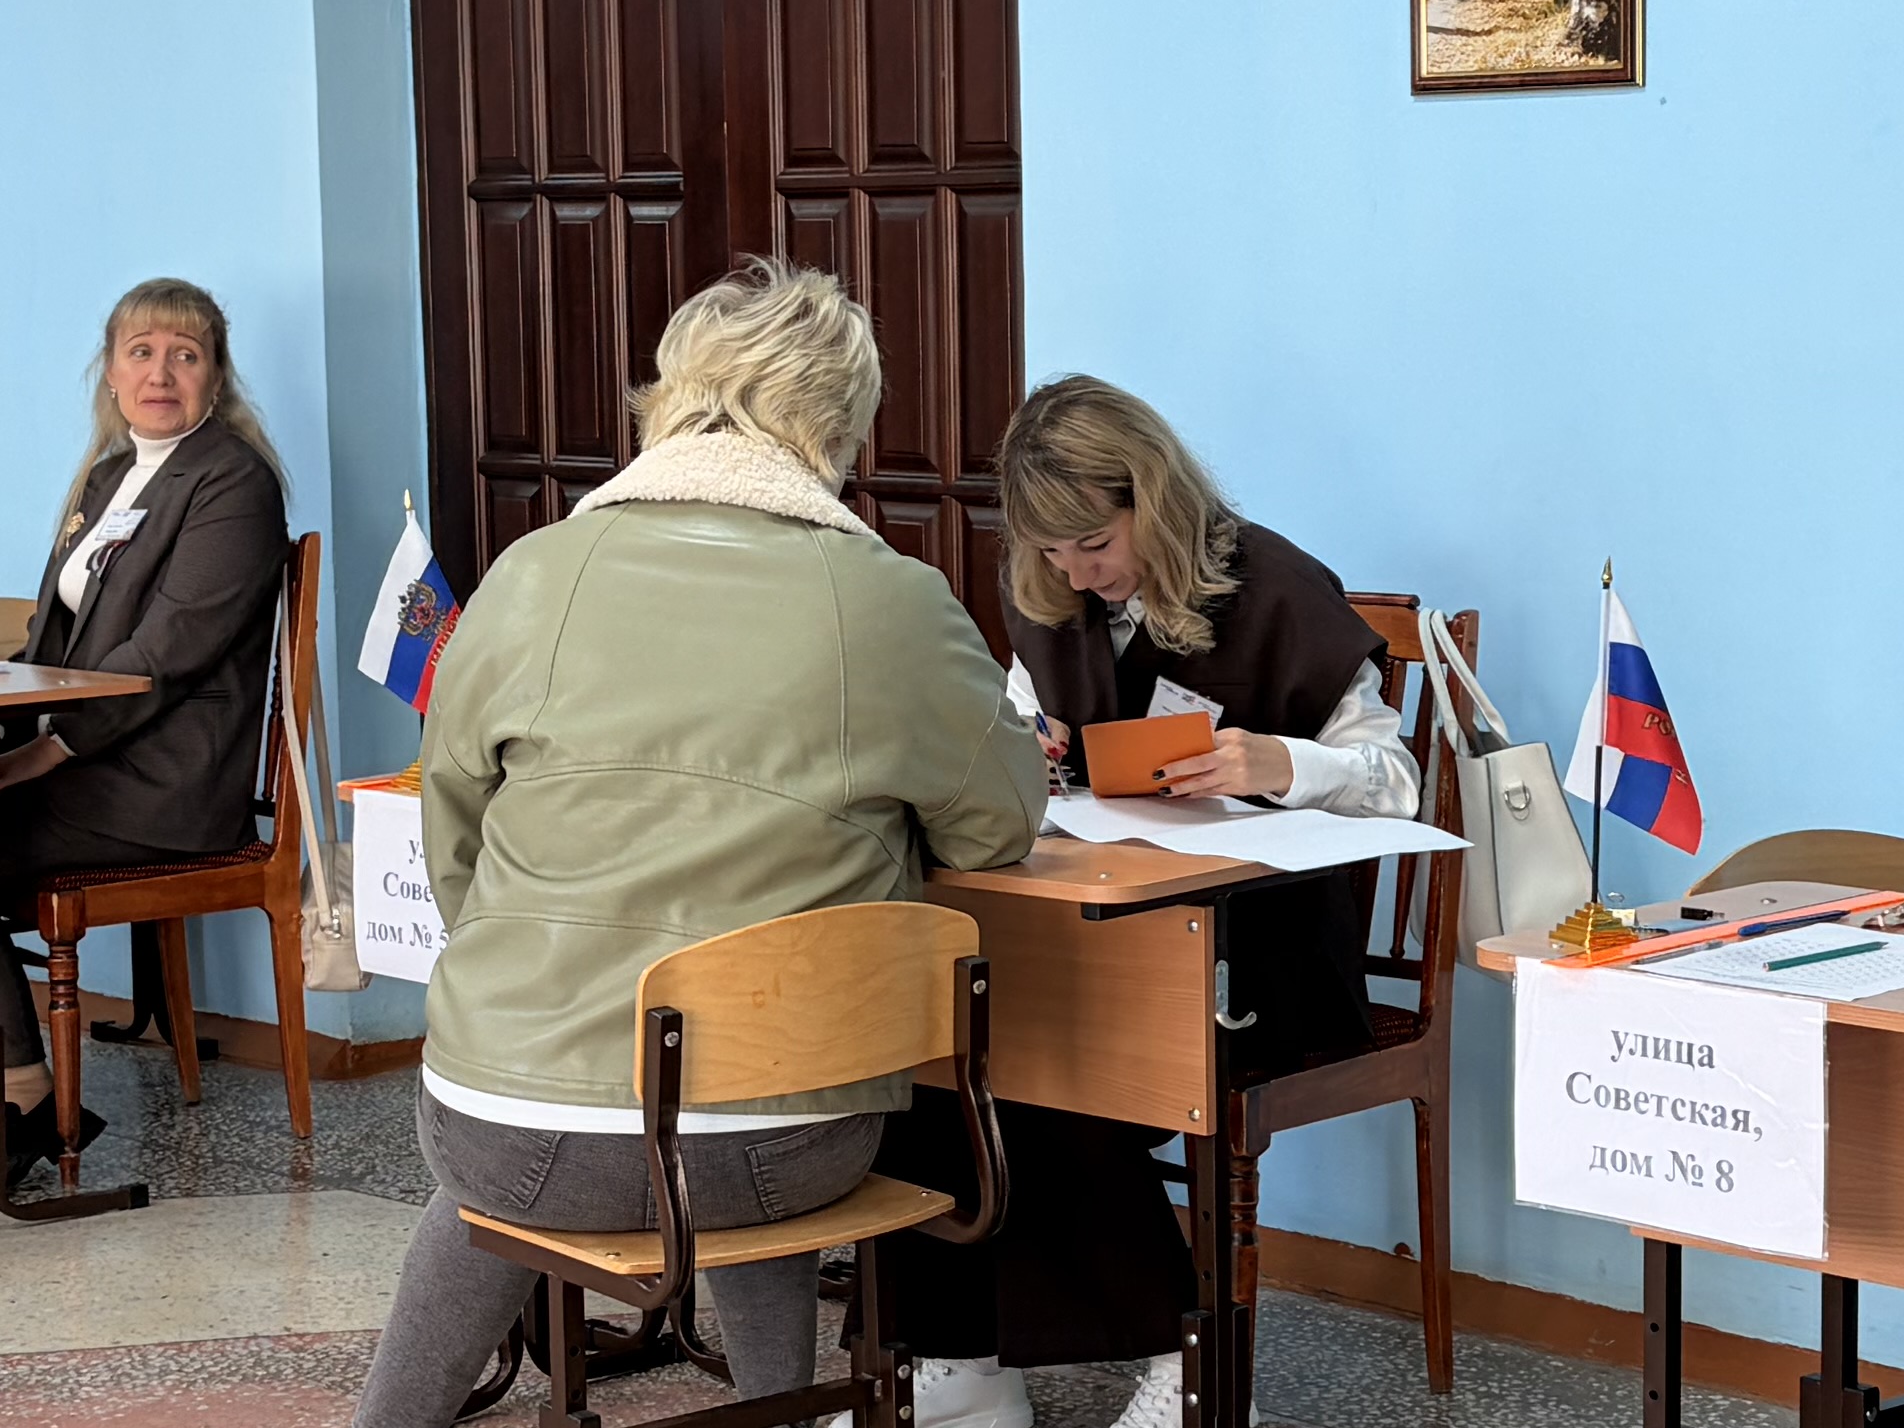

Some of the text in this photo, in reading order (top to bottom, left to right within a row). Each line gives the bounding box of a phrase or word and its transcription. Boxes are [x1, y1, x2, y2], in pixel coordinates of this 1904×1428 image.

[366, 921, 403, 945] дом
[409, 923, 432, 949] №
[1610, 1029, 1716, 1070] улица
[1565, 1071, 1764, 1142] Советская,
[1589, 1144, 1735, 1193] дом № 8
